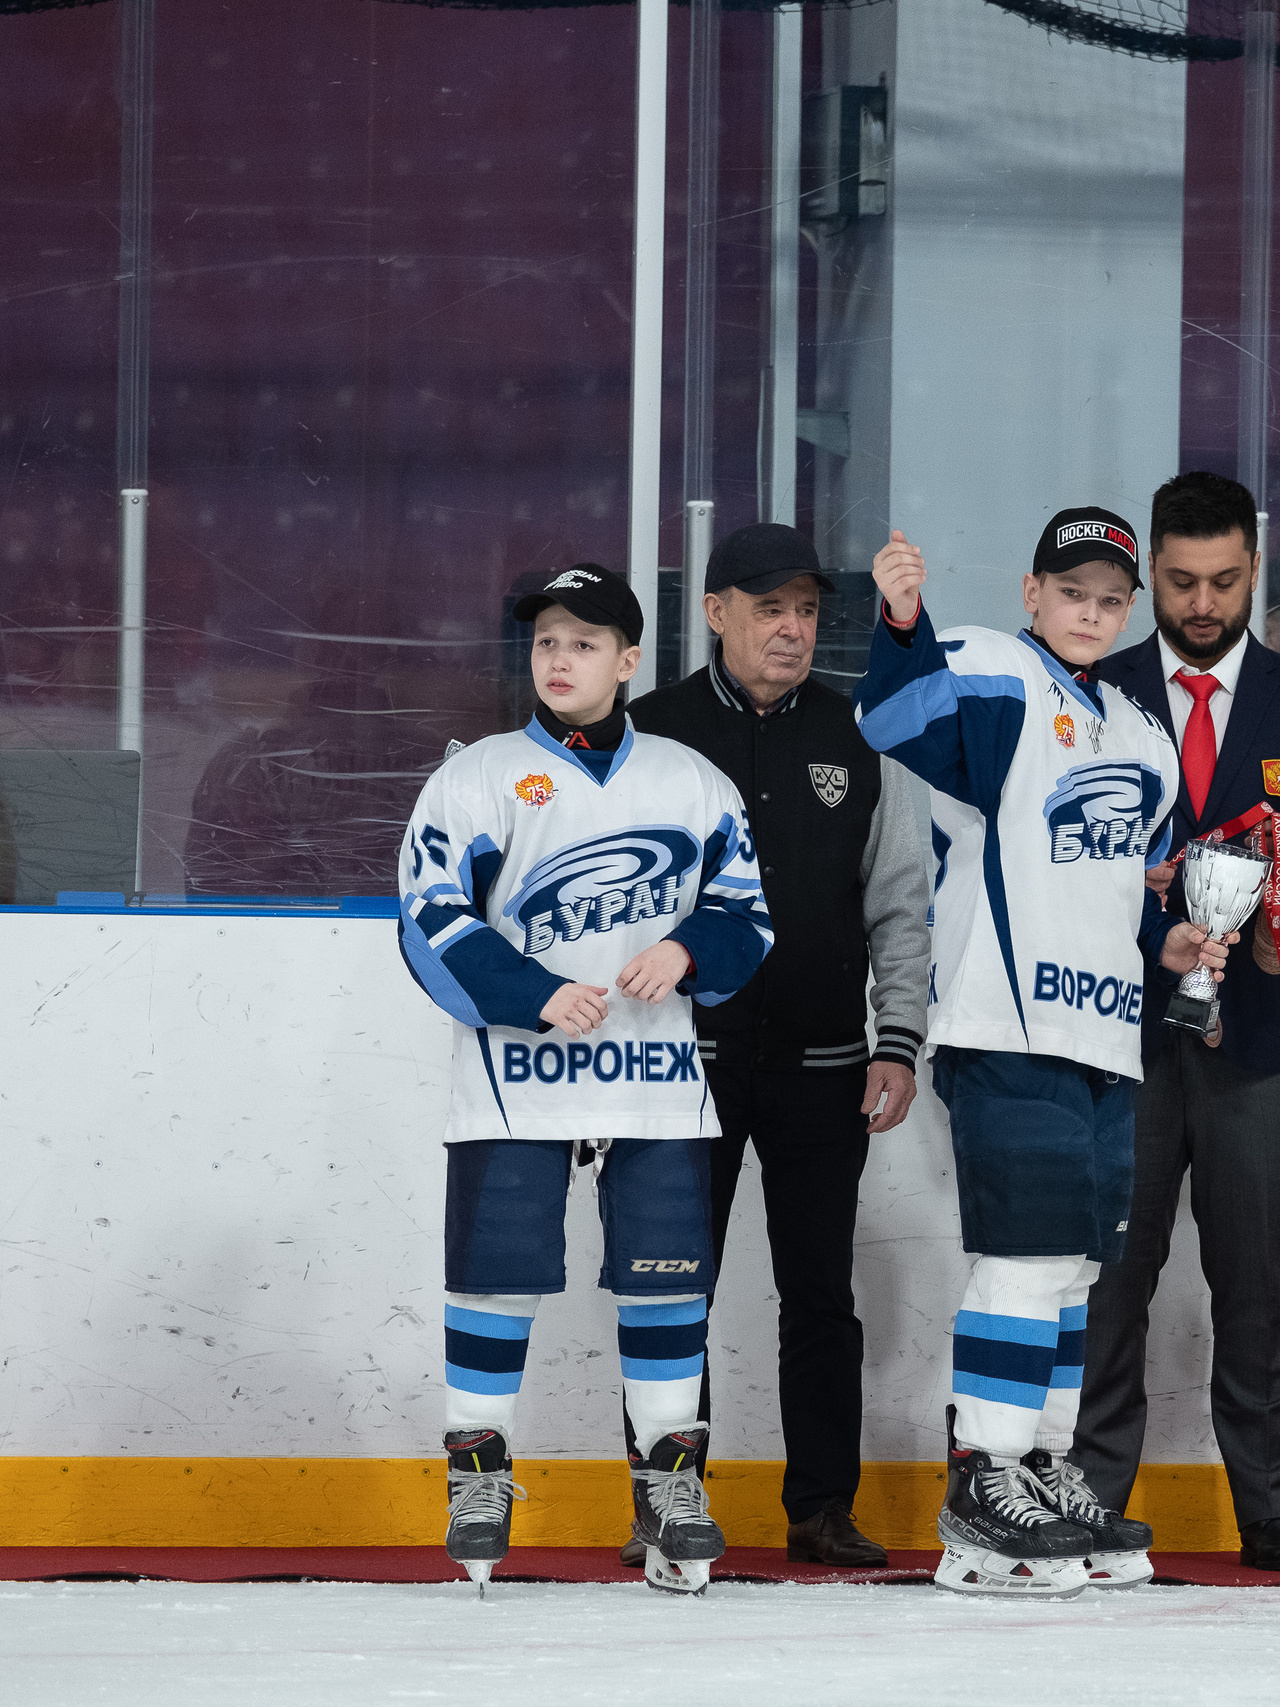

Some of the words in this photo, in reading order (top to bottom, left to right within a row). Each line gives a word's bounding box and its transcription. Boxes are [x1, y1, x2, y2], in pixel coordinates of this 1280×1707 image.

[1061, 524, 1107, 543] HOCKEY
[1108, 528, 1135, 556] MAFIA
[526, 783, 548, 801] 75
[1033, 960, 1143, 1026] ВОРОНЕ
[503, 1040, 700, 1084] ВОРОНЕЖ
[630, 1259, 700, 1274] CCM
[974, 1516, 1009, 1539] BAUER
